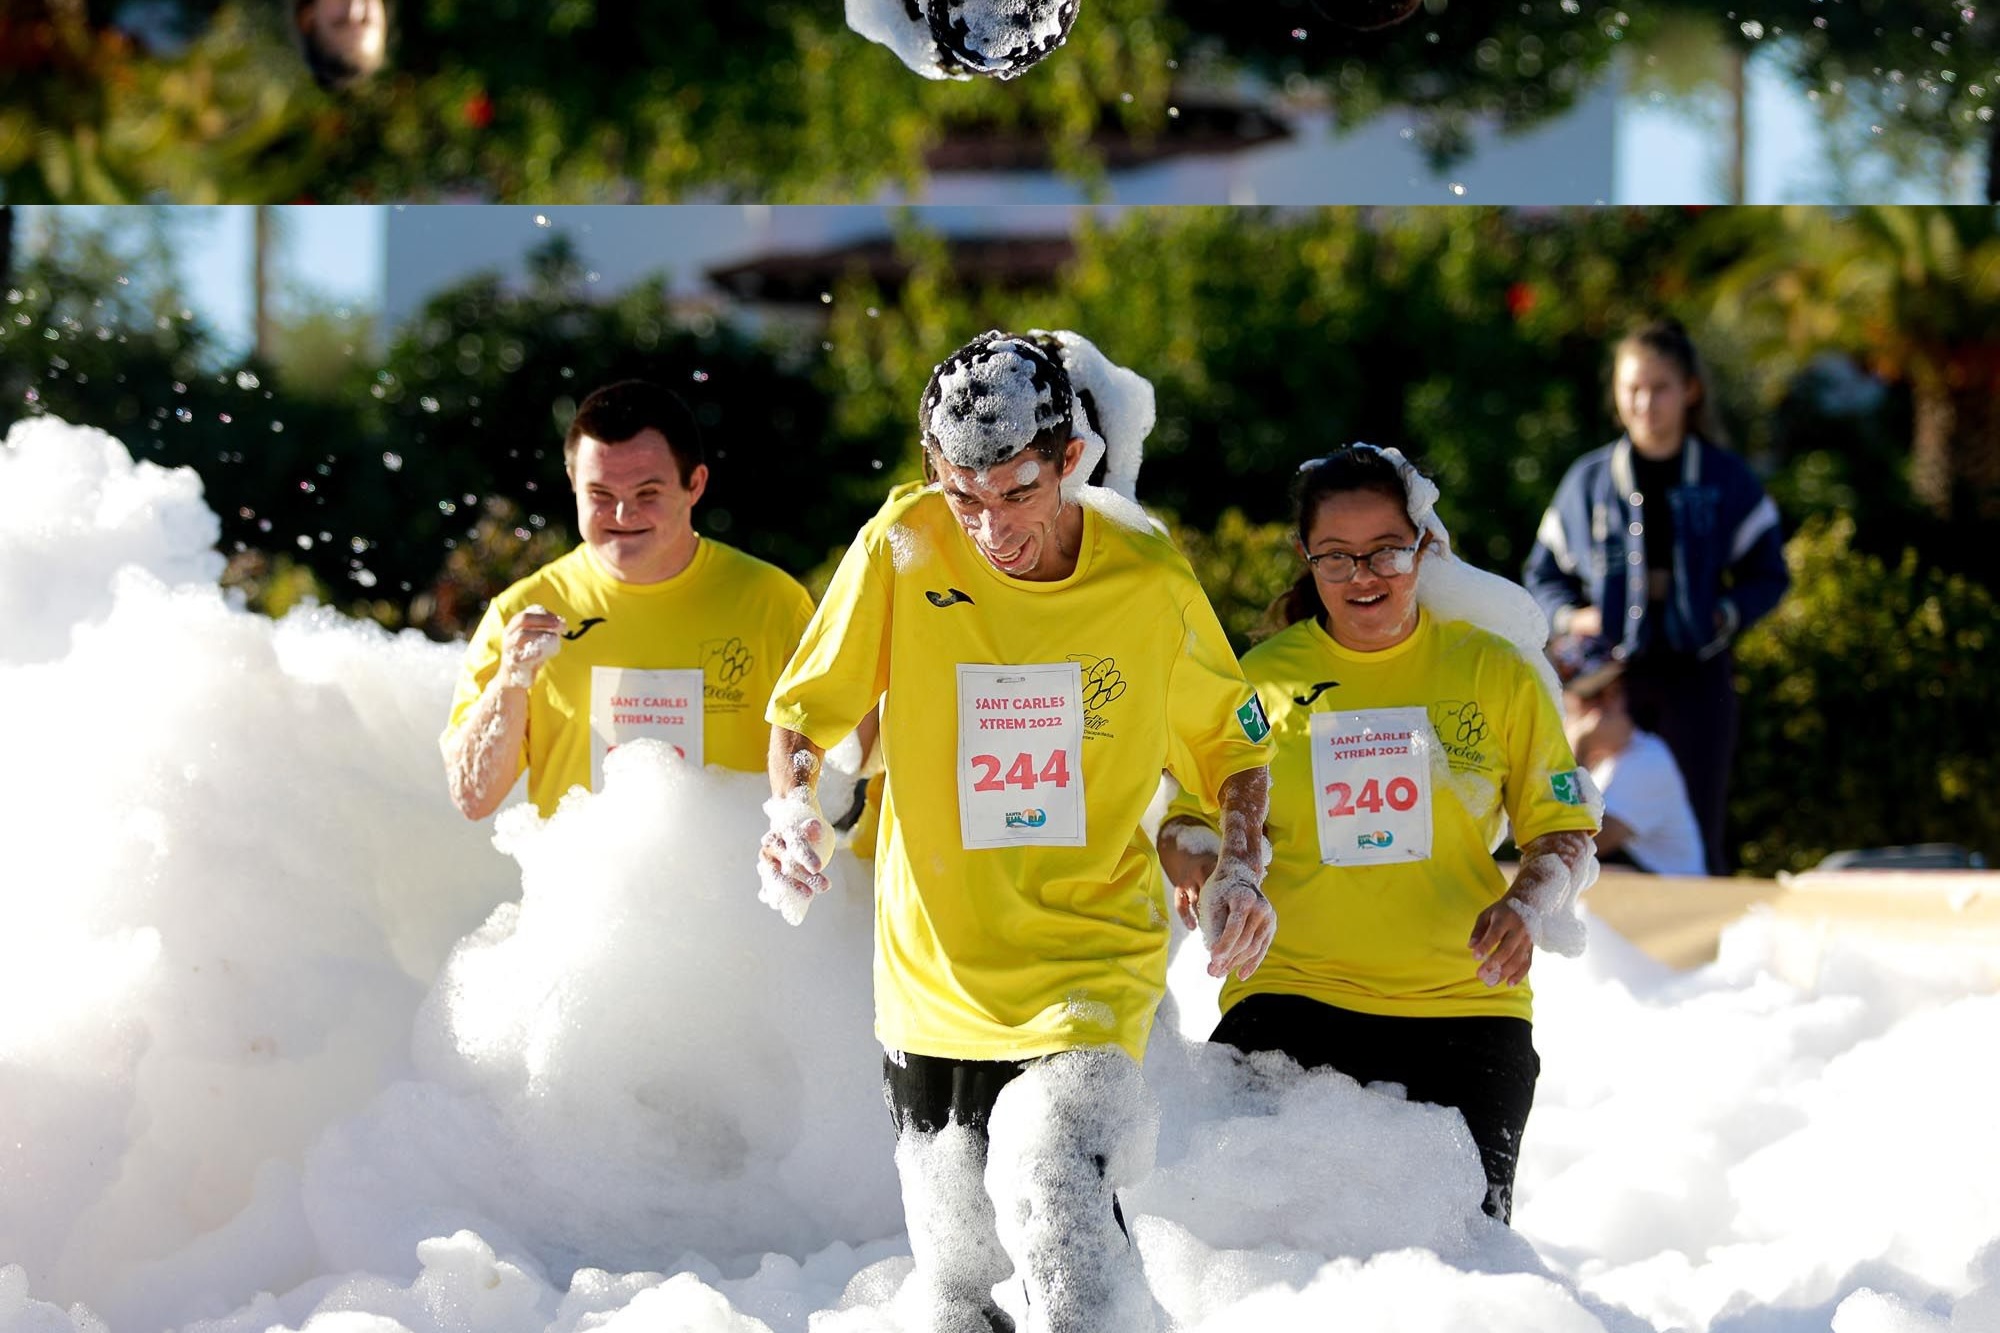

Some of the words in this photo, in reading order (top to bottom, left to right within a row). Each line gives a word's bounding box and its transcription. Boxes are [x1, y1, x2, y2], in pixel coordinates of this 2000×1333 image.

[610, 697, 640, 707] SANT
[643, 697, 688, 708] CARLES
[975, 698, 1009, 710] SANT
[1012, 696, 1065, 710] CARLES
[613, 714, 653, 724] XTREM
[656, 716, 685, 725] 2022
[980, 717, 1026, 730] XTREM
[1029, 716, 1063, 729] 2022
[1330, 734, 1361, 746] SANT
[1334, 747, 1376, 760] XTREM
[1379, 746, 1408, 756] 2022
[970, 748, 1070, 792] 244
[1325, 776, 1418, 818] 240
